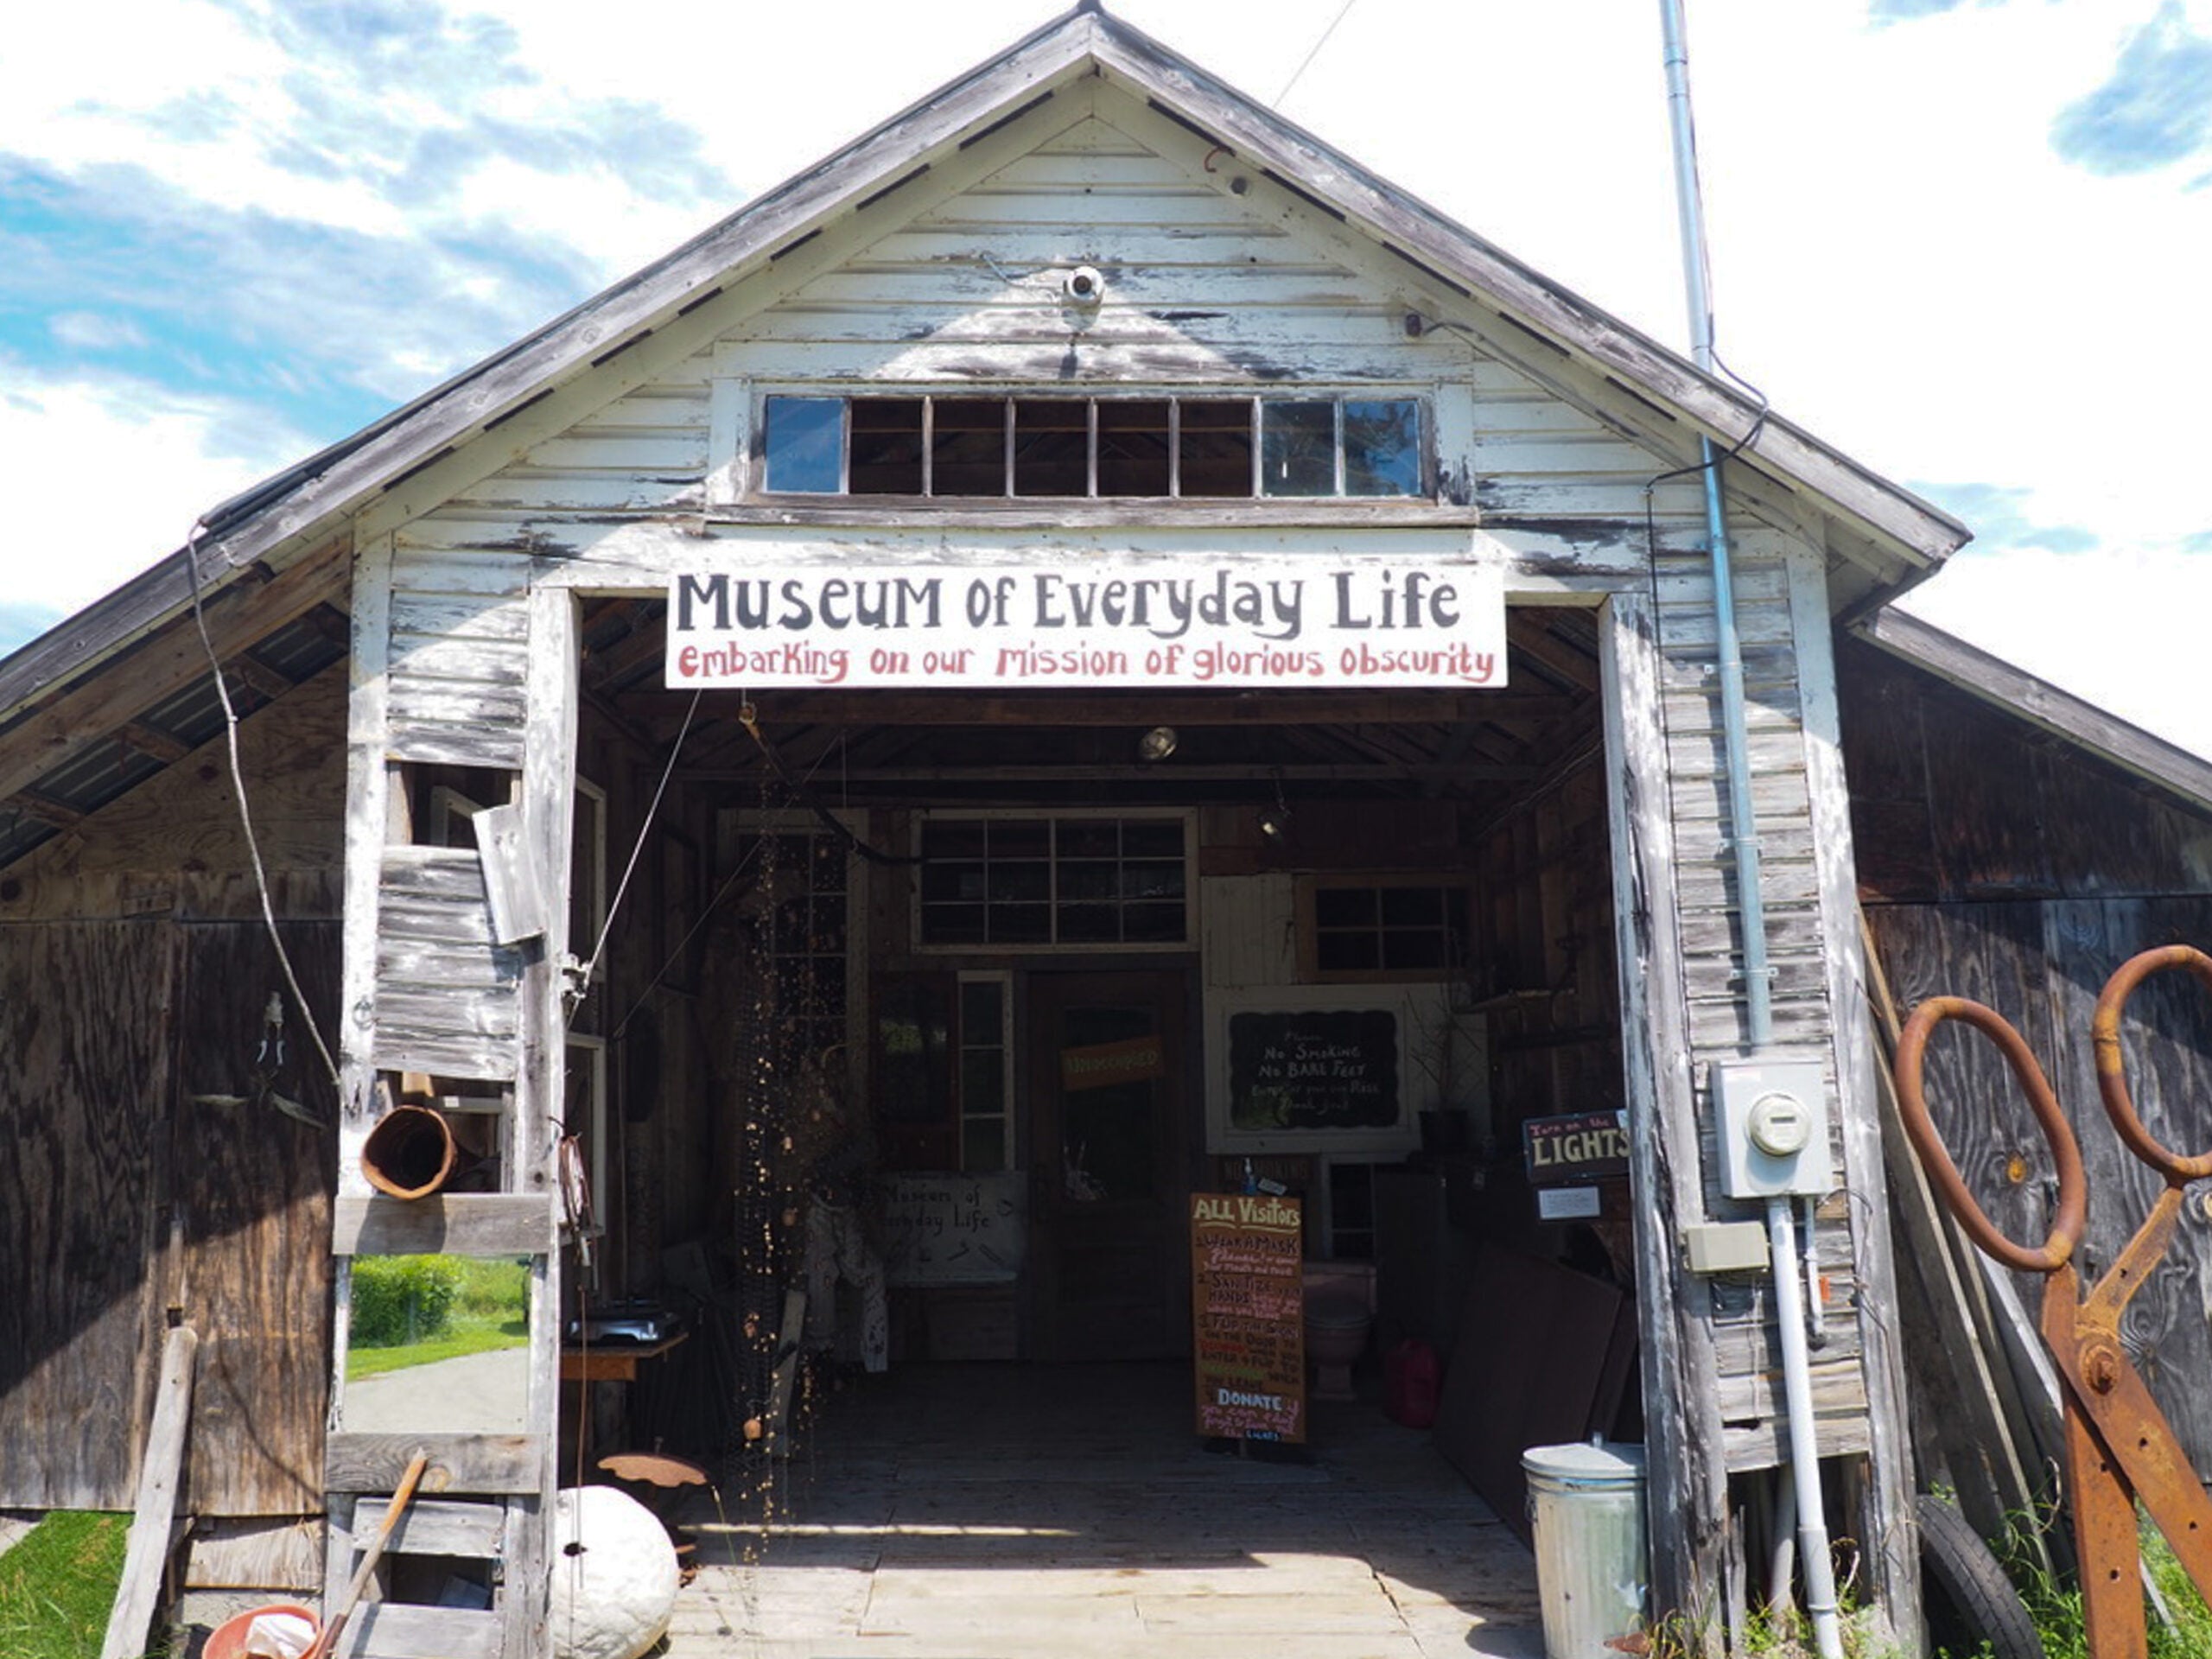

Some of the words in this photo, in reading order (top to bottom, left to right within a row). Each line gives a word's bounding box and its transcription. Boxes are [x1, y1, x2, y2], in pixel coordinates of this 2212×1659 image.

[966, 575, 1016, 628] of
[1033, 569, 1307, 640] Everyday
[1329, 569, 1460, 629] Life
[678, 639, 850, 683] embarking
[869, 646, 910, 675] on
[922, 647, 975, 675] our
[995, 639, 1127, 677] mission
[1146, 643, 1185, 676] of
[1192, 640, 1325, 682] glorious
[1339, 641, 1495, 683] obscurity
[1529, 1123, 1562, 1136] Turn
[1532, 1128, 1630, 1166] LIGHTS
[1193, 1198, 1236, 1221] ALL
[1217, 1387, 1283, 1411] DONATE
